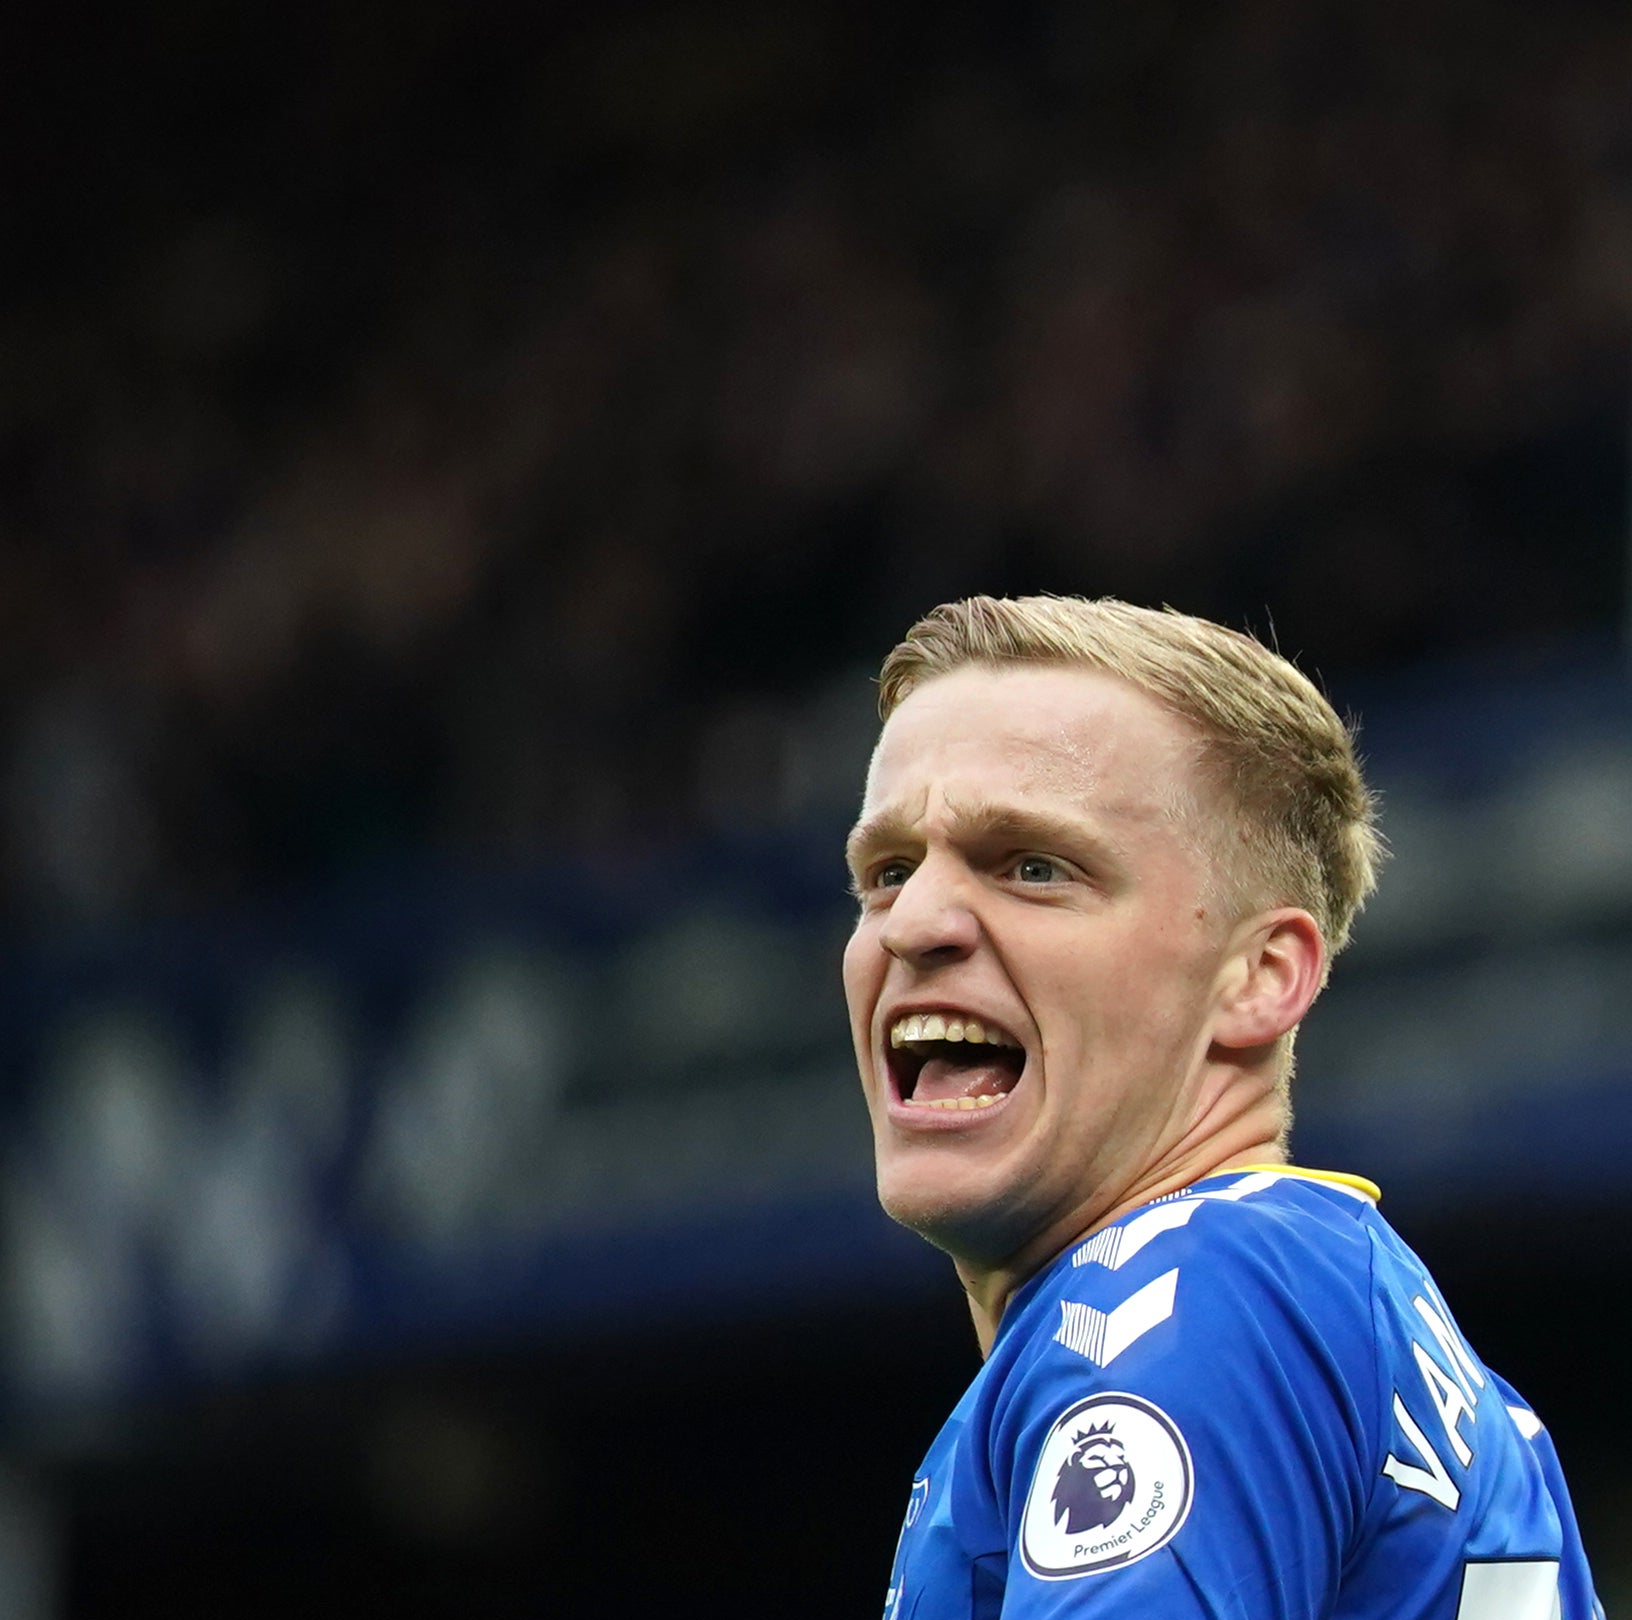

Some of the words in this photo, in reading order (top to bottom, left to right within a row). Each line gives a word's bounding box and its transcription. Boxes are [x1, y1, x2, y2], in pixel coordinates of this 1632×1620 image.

[1382, 1278, 1486, 1512] VAN
[1073, 1531, 1133, 1558] Premier
[1130, 1480, 1166, 1533] League
